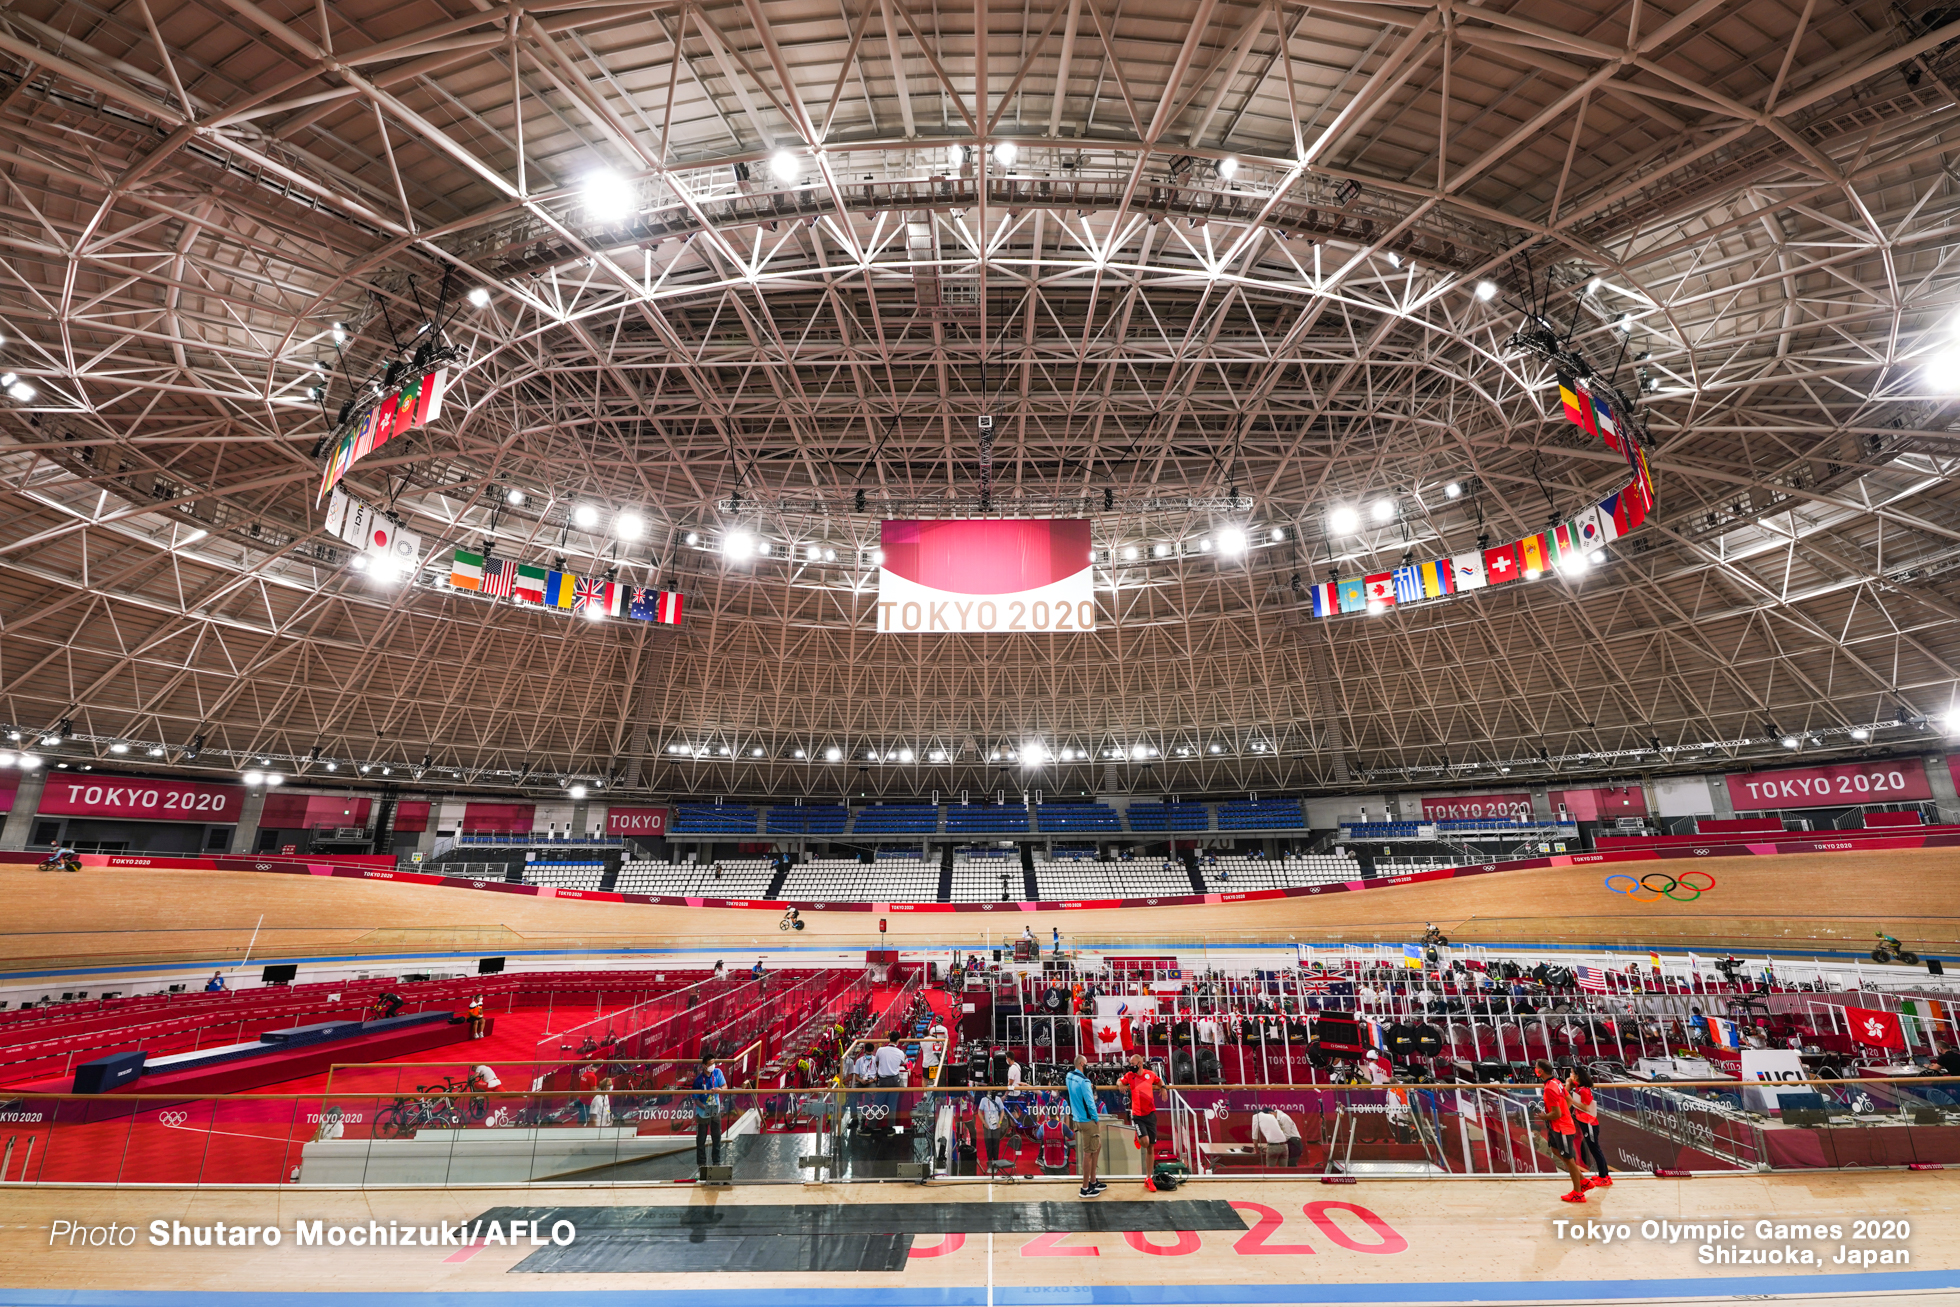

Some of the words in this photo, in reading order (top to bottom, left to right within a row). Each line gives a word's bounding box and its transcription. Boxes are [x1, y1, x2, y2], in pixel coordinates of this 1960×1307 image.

[355, 508, 364, 526] UCI
[879, 600, 997, 631] TOKYO
[1008, 599, 1095, 630] 2020
[1746, 778, 1831, 799] TOKYO
[1836, 771, 1905, 794] 2020
[68, 785, 158, 808] TOKYO
[163, 791, 226, 811] 2020
[1425, 804, 1482, 819] TOKYO
[610, 815, 661, 828] TOKYO
[364, 871, 381, 879] TOKYO
[1709, 1057, 1736, 1070] TOYO
[1764, 1070, 1806, 1087] UCI
[1026, 1105, 1058, 1116] TOKYO
[1058, 1105, 1073, 1116] 20
[1351, 1103, 1383, 1114] TOKYO
[1385, 1103, 1408, 1114] 2020
[1676, 1100, 1710, 1111] TOKYO
[1710, 1100, 1732, 1111] 2020
[19, 1112, 43, 1123] 2020
[306, 1113, 338, 1124] TOKYO
[339, 1113, 363, 1124] 2020
[638, 1109, 669, 1120] TOKYO
[670, 1109, 694, 1120] 2020
[1618, 1147, 1654, 1172] United
